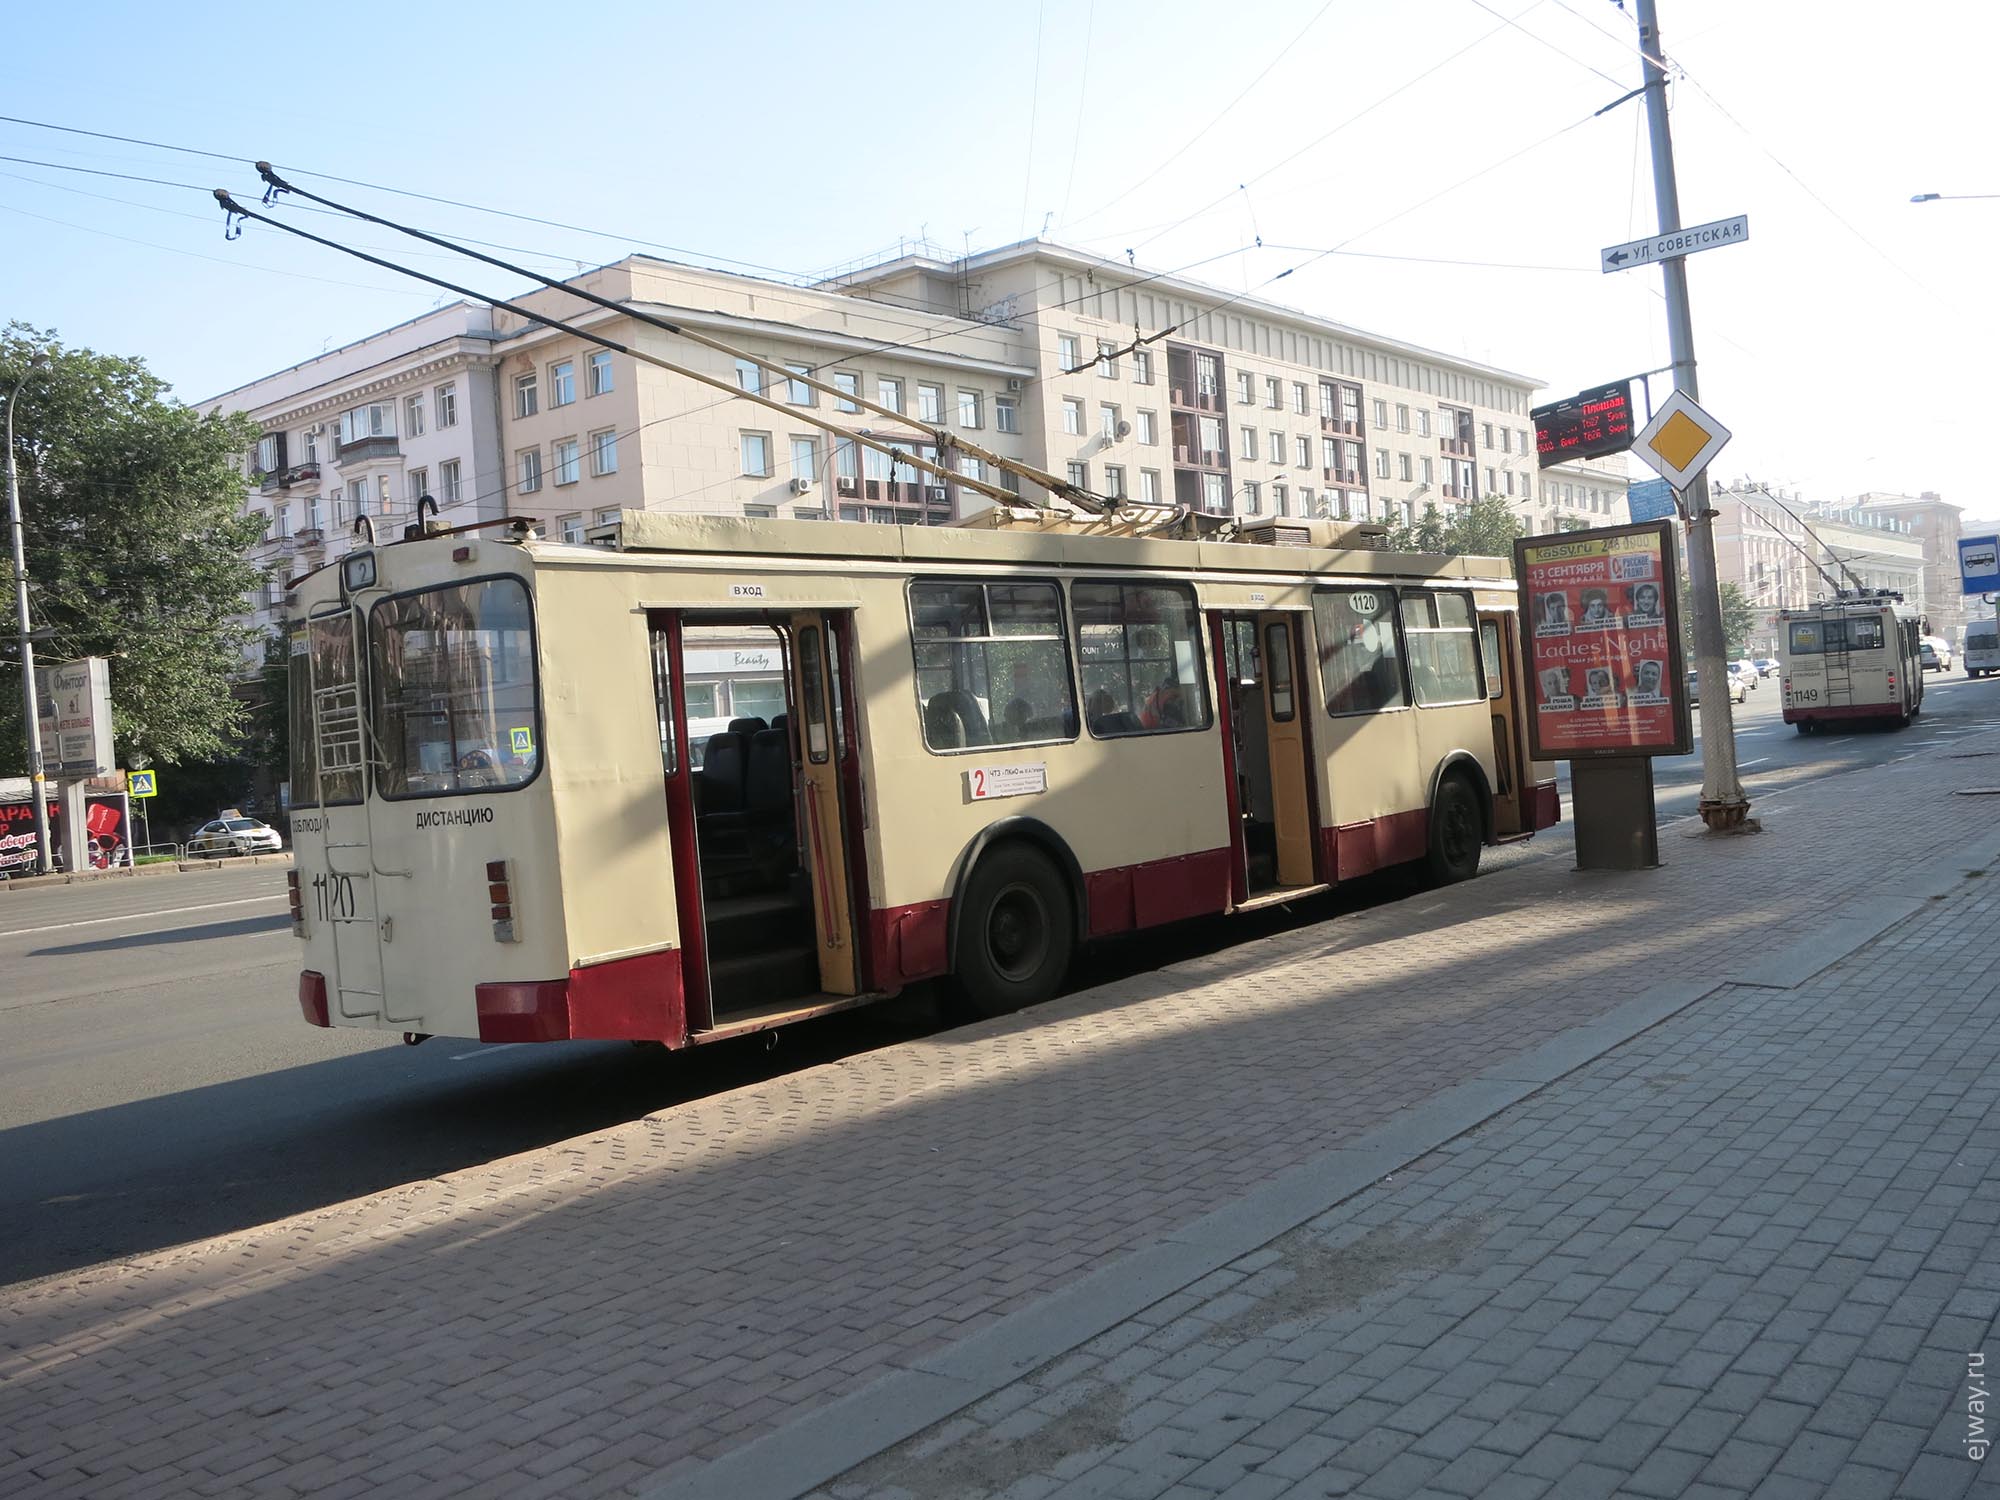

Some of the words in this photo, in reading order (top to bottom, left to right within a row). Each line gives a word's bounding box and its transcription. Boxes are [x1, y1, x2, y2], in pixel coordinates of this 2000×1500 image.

[1633, 245, 1653, 260] УЛ.
[1657, 223, 1742, 253] СОВЕТСКАЯ
[1536, 543, 1592, 561] kassy.ru
[358, 562, 368, 583] 2
[1532, 569, 1545, 580] 13
[1548, 561, 1605, 578] СЕНТЯБРЯ
[1535, 579, 1562, 588] ТЕАТР
[1569, 575, 1604, 585] ДРАМЫ
[734, 586, 762, 597] ВХОД
[1352, 595, 1375, 611] 1120
[734, 651, 769, 669] Beauty
[1793, 688, 1818, 702] 1149
[989, 769, 1001, 777] ЧТЗ
[974, 769, 986, 797] 2
[416, 807, 494, 829] ДИСТАНЦИЮ
[313, 873, 355, 923] 1120
